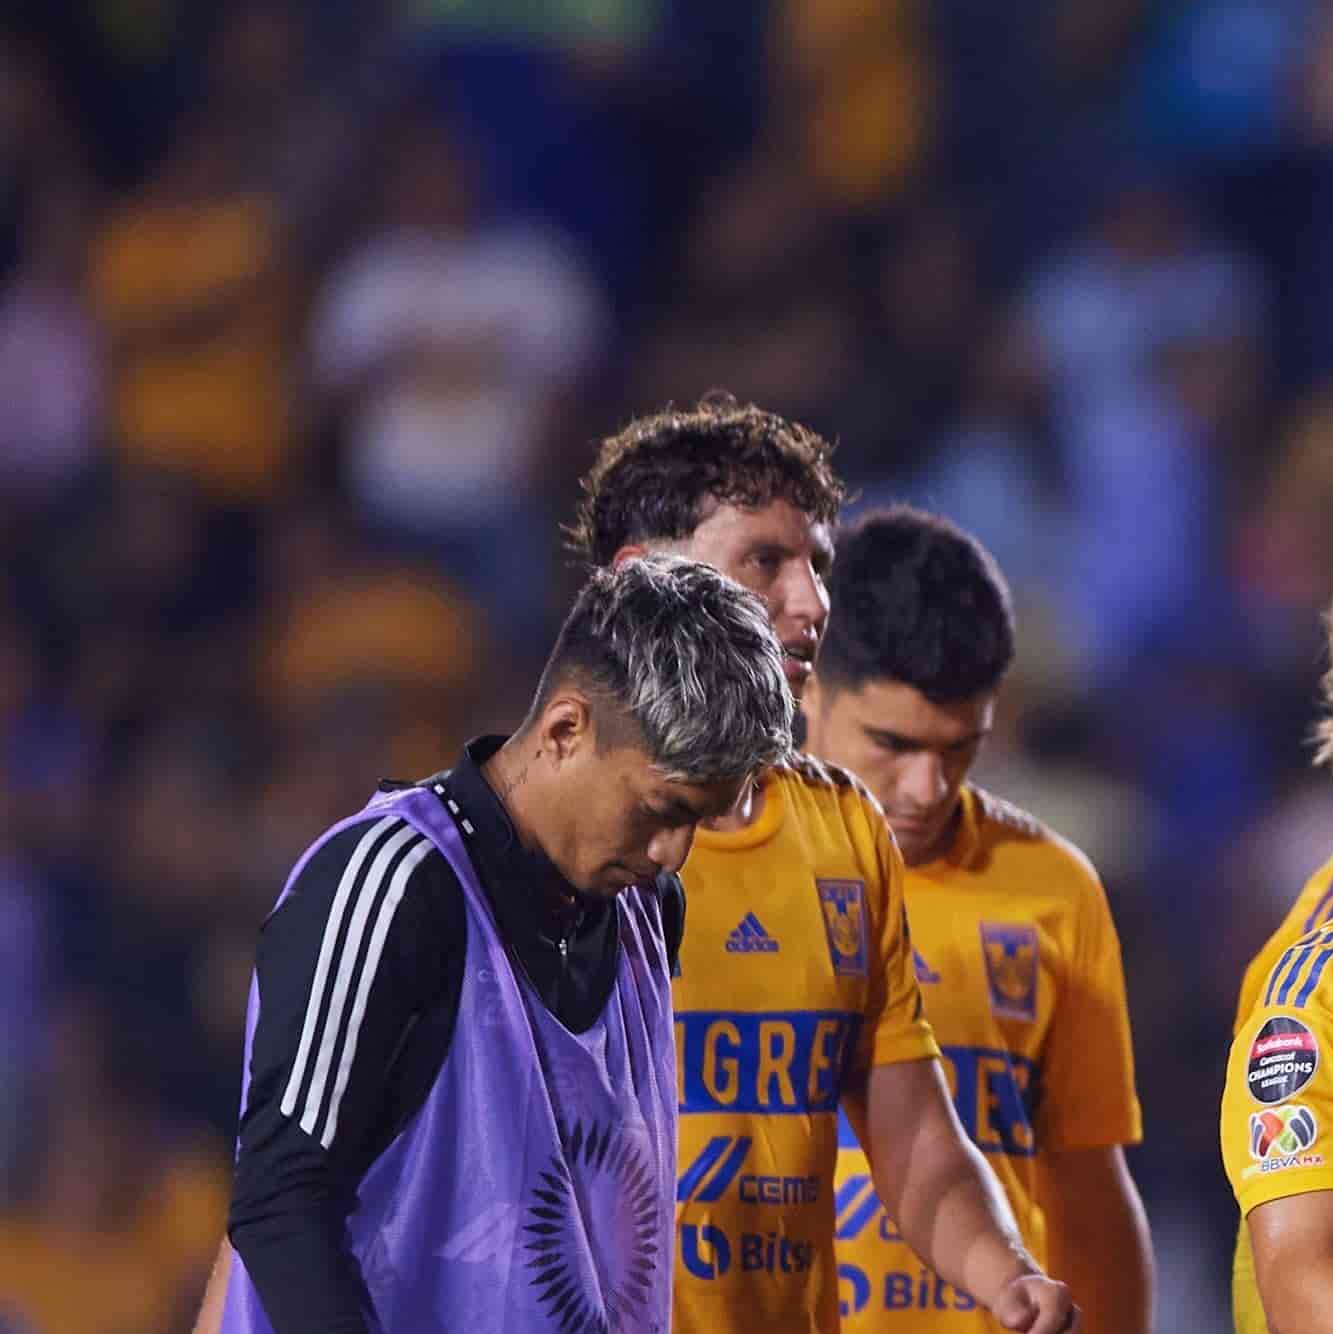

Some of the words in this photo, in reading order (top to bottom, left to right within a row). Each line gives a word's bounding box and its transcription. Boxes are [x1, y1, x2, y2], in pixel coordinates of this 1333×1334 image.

[1249, 1062, 1312, 1082] CHAMPIONS
[740, 1233, 814, 1273] Bits
[884, 1272, 977, 1311] Bits
